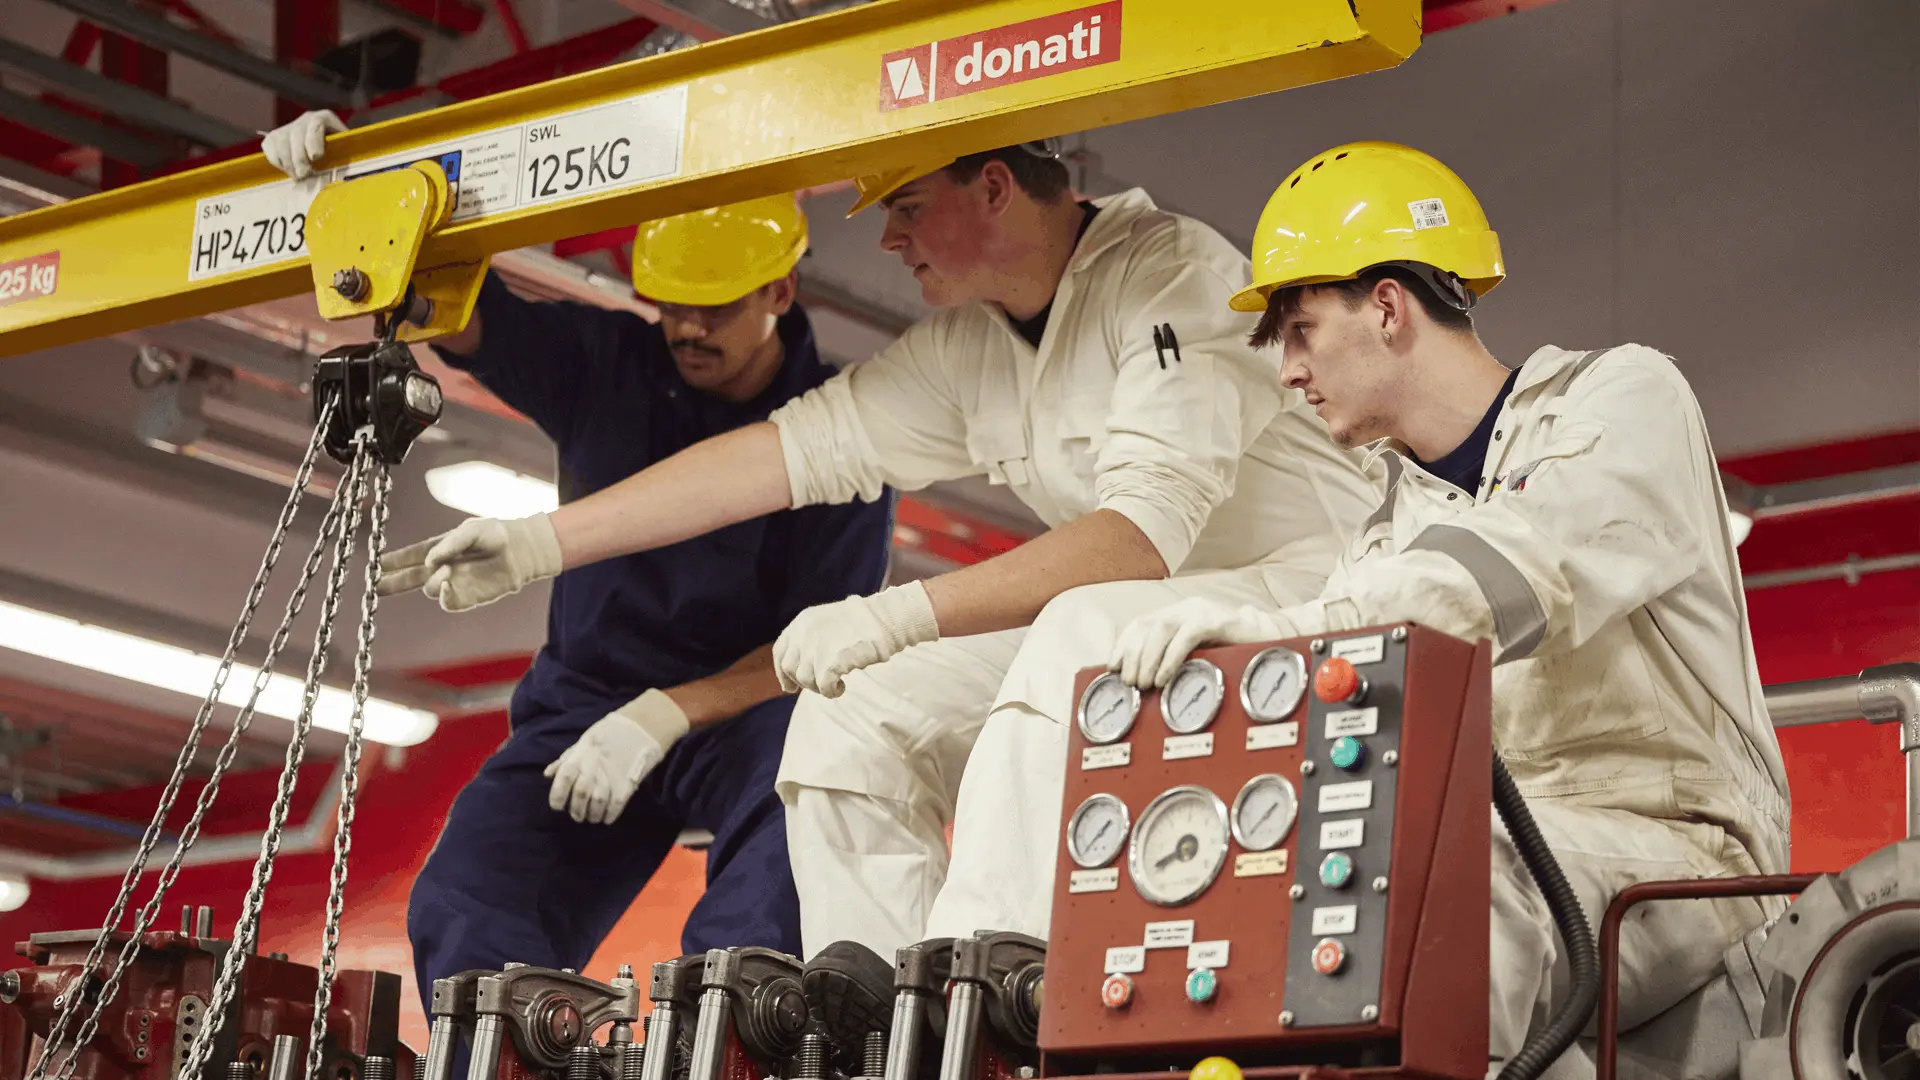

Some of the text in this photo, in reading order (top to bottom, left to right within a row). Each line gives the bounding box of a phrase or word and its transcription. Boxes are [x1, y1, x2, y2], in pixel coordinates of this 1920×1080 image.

[954, 15, 1101, 86] donati
[529, 124, 561, 143] SWL
[528, 137, 631, 199] 125KG
[196, 213, 306, 272] HP4703
[30, 263, 57, 295] kg
